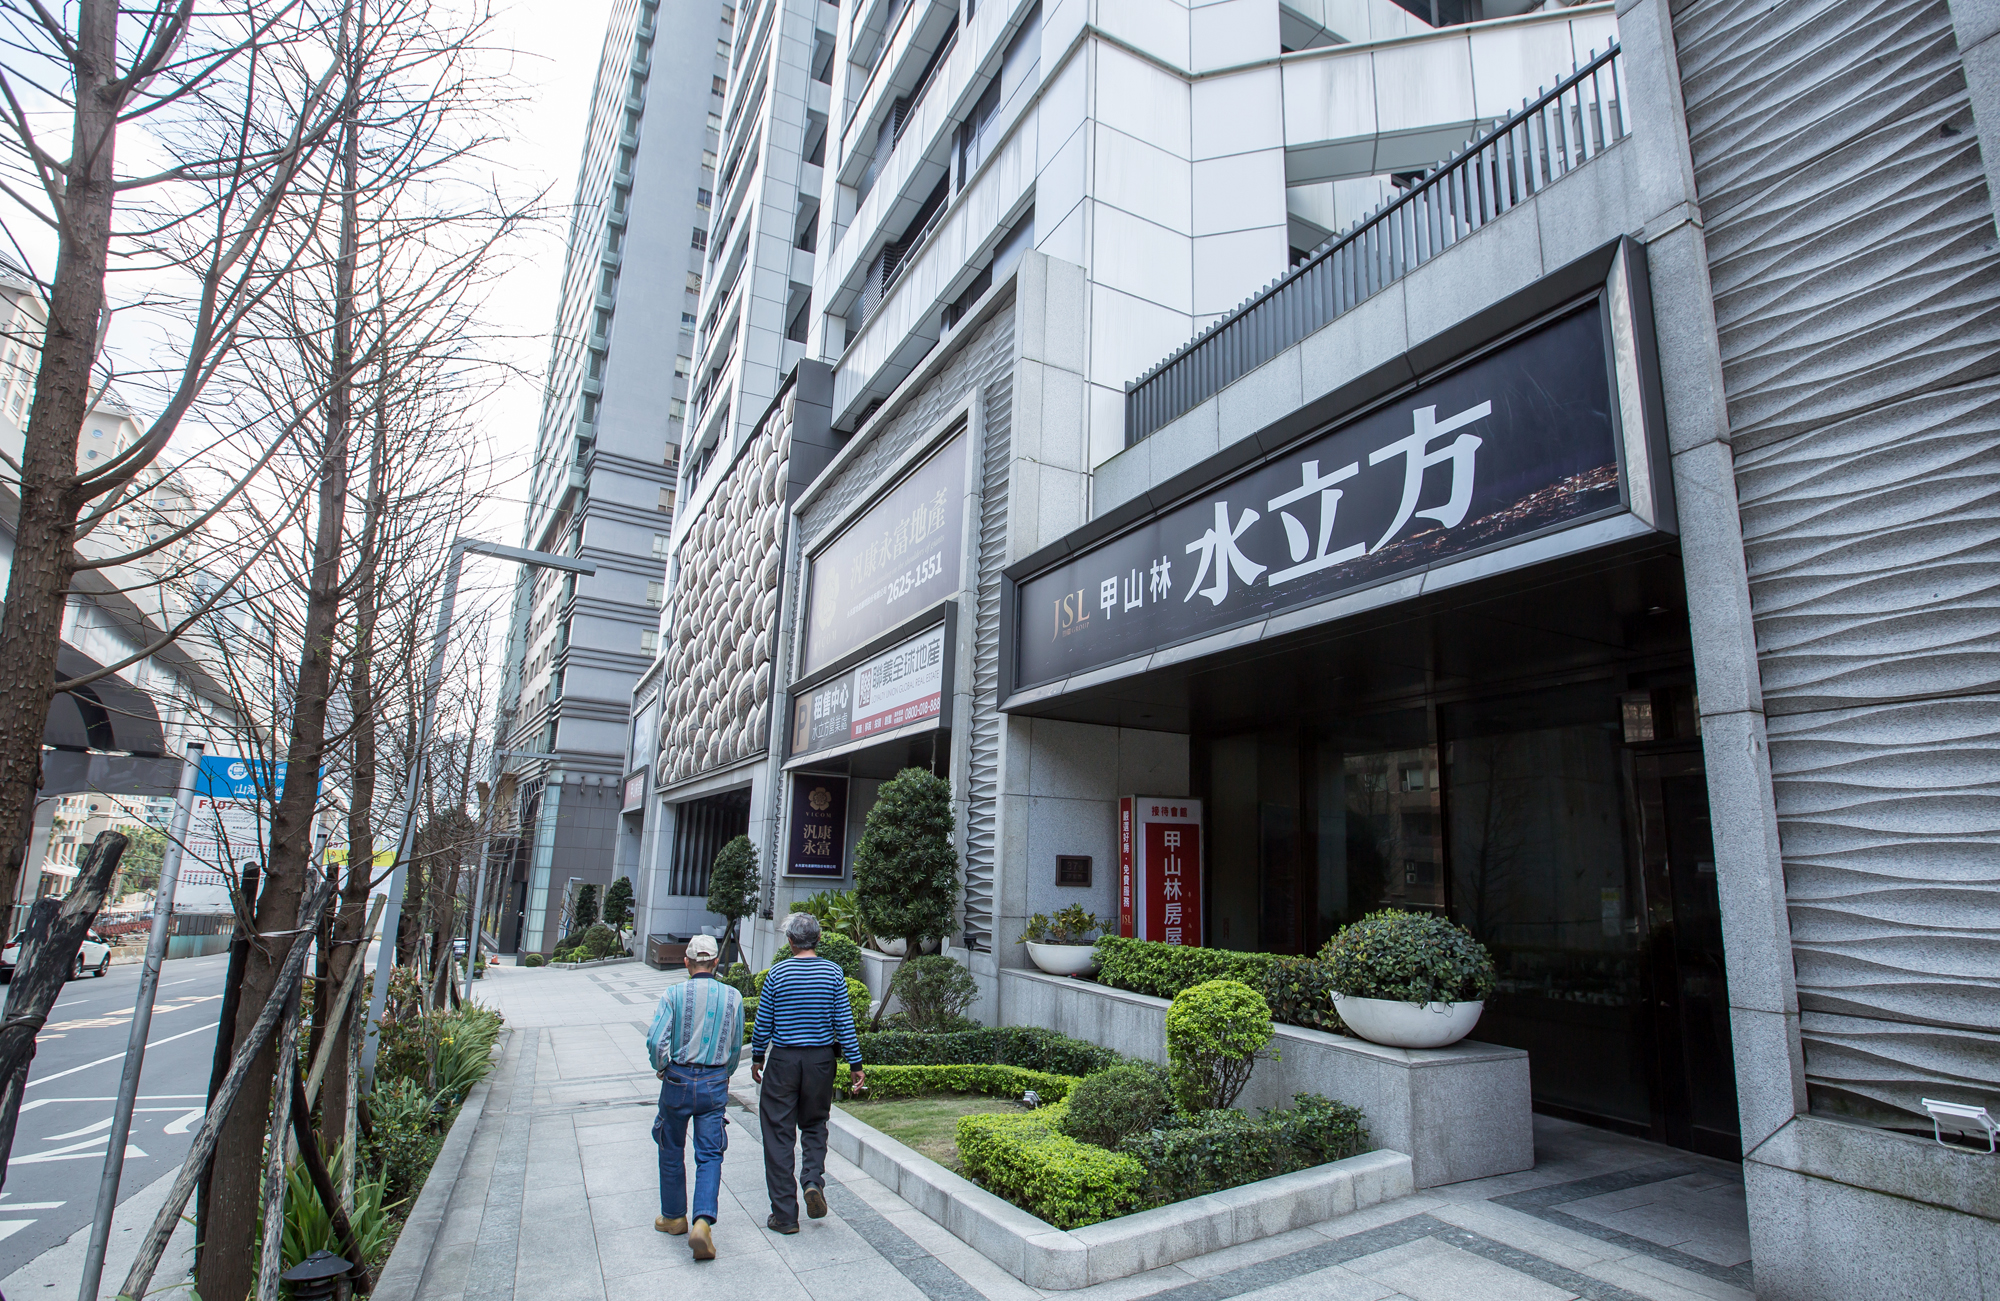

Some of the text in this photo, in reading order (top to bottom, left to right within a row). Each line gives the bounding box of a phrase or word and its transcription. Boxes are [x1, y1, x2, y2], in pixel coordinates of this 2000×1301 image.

[1183, 400, 1492, 606] 水立方
[886, 551, 943, 605] 2625-1551
[1100, 556, 1172, 620] 甲山林
[1051, 588, 1090, 643] JSL
[1071, 621, 1090, 634] GROUP
[898, 681, 914, 694] GLOBAL
[915, 677, 926, 687] REAL
[925, 669, 940, 683] ESTATE
[814, 682, 849, 721] 租售中心
[796, 704, 808, 746] P
[234, 784, 283, 797] 山海地
[1151, 806, 1188, 818] 接待會館
[802, 839, 831, 856] 永富
[803, 823, 832, 840] 汎康
[1163, 830, 1183, 946] 甲山林房屋
[1122, 914, 1131, 924] JSL
